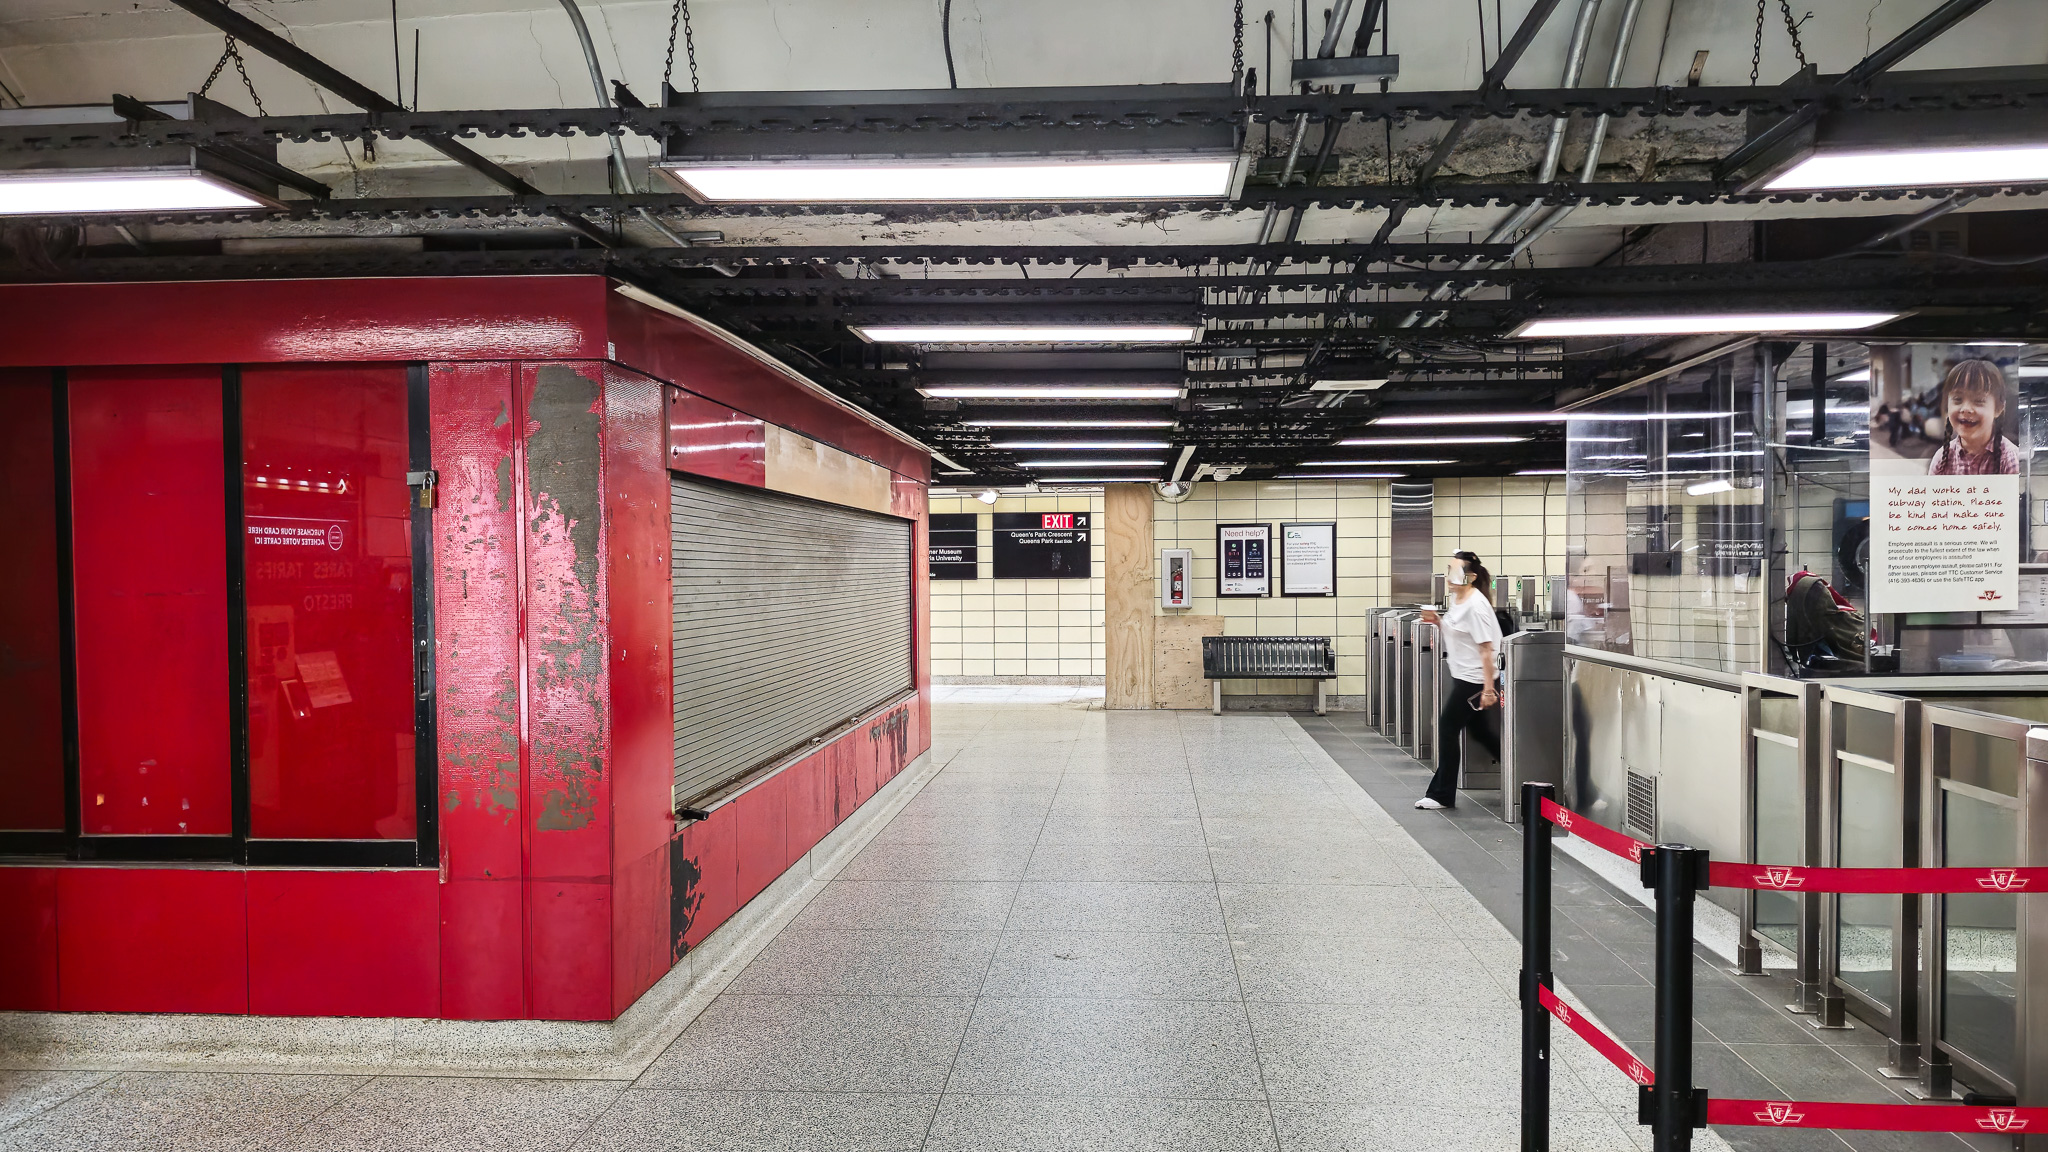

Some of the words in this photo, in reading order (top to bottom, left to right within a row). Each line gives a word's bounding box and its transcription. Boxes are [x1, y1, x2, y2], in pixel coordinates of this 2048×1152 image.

[1888, 487, 1901, 496] My
[1932, 486, 1960, 494] works
[1966, 486, 1977, 494] at
[1888, 499, 1925, 508] subway
[1932, 498, 1965, 507] station.
[1971, 498, 2002, 506] Please
[1889, 511, 1902, 519] be
[1908, 511, 1925, 519] kind
[1932, 511, 1948, 519] and
[1954, 510, 1979, 518] make
[1044, 514, 1070, 529] EXIT
[1972, 522, 2001, 532] safely.
